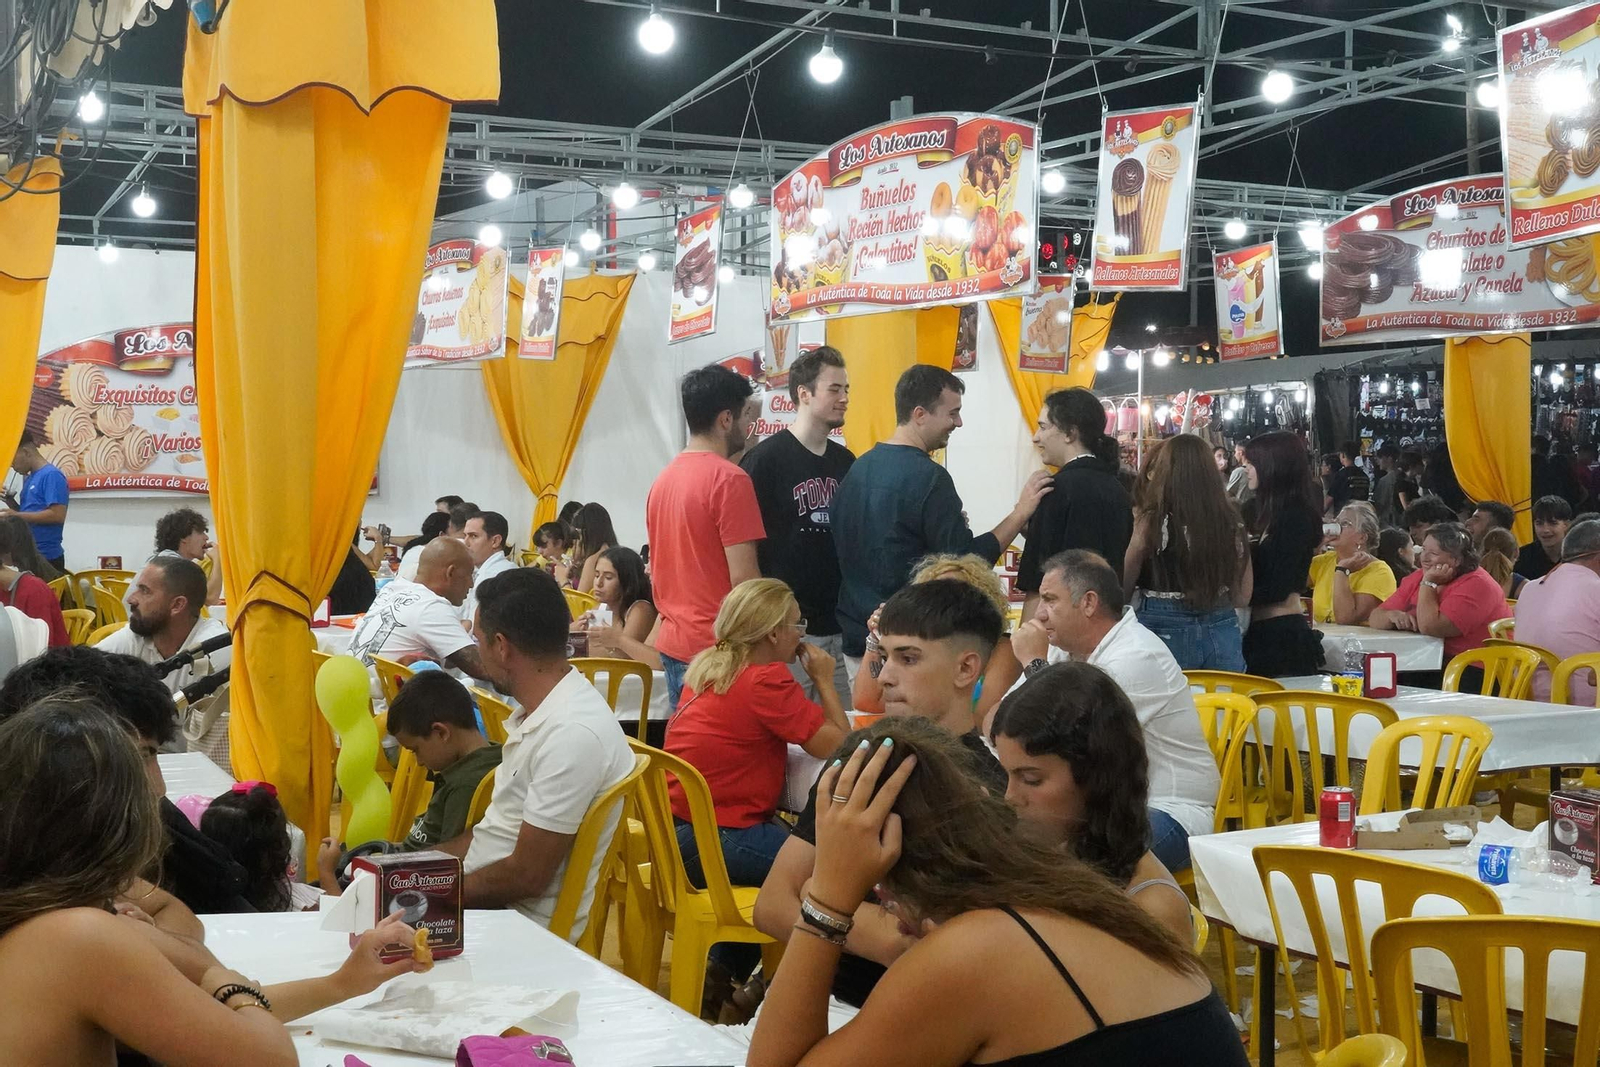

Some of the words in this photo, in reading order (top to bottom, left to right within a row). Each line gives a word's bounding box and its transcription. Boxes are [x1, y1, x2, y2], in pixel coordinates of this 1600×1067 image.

[839, 142, 865, 172] Los
[868, 129, 947, 159] Artesanos
[861, 178, 917, 210] Buñuelos
[1404, 193, 1437, 216] Los
[1442, 186, 1504, 206] Artesa
[847, 213, 883, 241] Recién
[886, 205, 927, 235] Hechos
[1513, 211, 1569, 237] Rellenos
[1426, 226, 1488, 251] Churritos
[1489, 223, 1506, 246] de
[1094, 265, 1129, 280] Rellenos
[1128, 264, 1179, 281] Artesanales
[1461, 252, 1493, 275] olate
[1495, 254, 1506, 269] o
[807, 291, 816, 305] La
[817, 286, 856, 302] Auténtica
[857, 287, 868, 298] de
[870, 286, 892, 300] Toda
[893, 287, 903, 301] la
[904, 286, 924, 301] Vida
[926, 285, 953, 299] desde
[955, 278, 980, 296] 1932
[1461, 281, 1472, 303] y
[1366, 317, 1378, 329] La
[1380, 312, 1428, 327] Auténtica
[1429, 313, 1443, 325] de
[1444, 313, 1471, 327] Toda
[1473, 314, 1484, 327] la
[1548, 309, 1578, 325] 1932
[124, 332, 168, 356] Los
[93, 384, 177, 408] Exquisitos
[143, 432, 202, 459] ¡Varios
[86, 477, 100, 488] La
[104, 476, 163, 488] Auténtica
[166, 476, 181, 488] de
[1570, 845, 1597, 857] Chocolate
[389, 873, 455, 889] CaoArtesano
[416, 919, 456, 929] Chocolate
